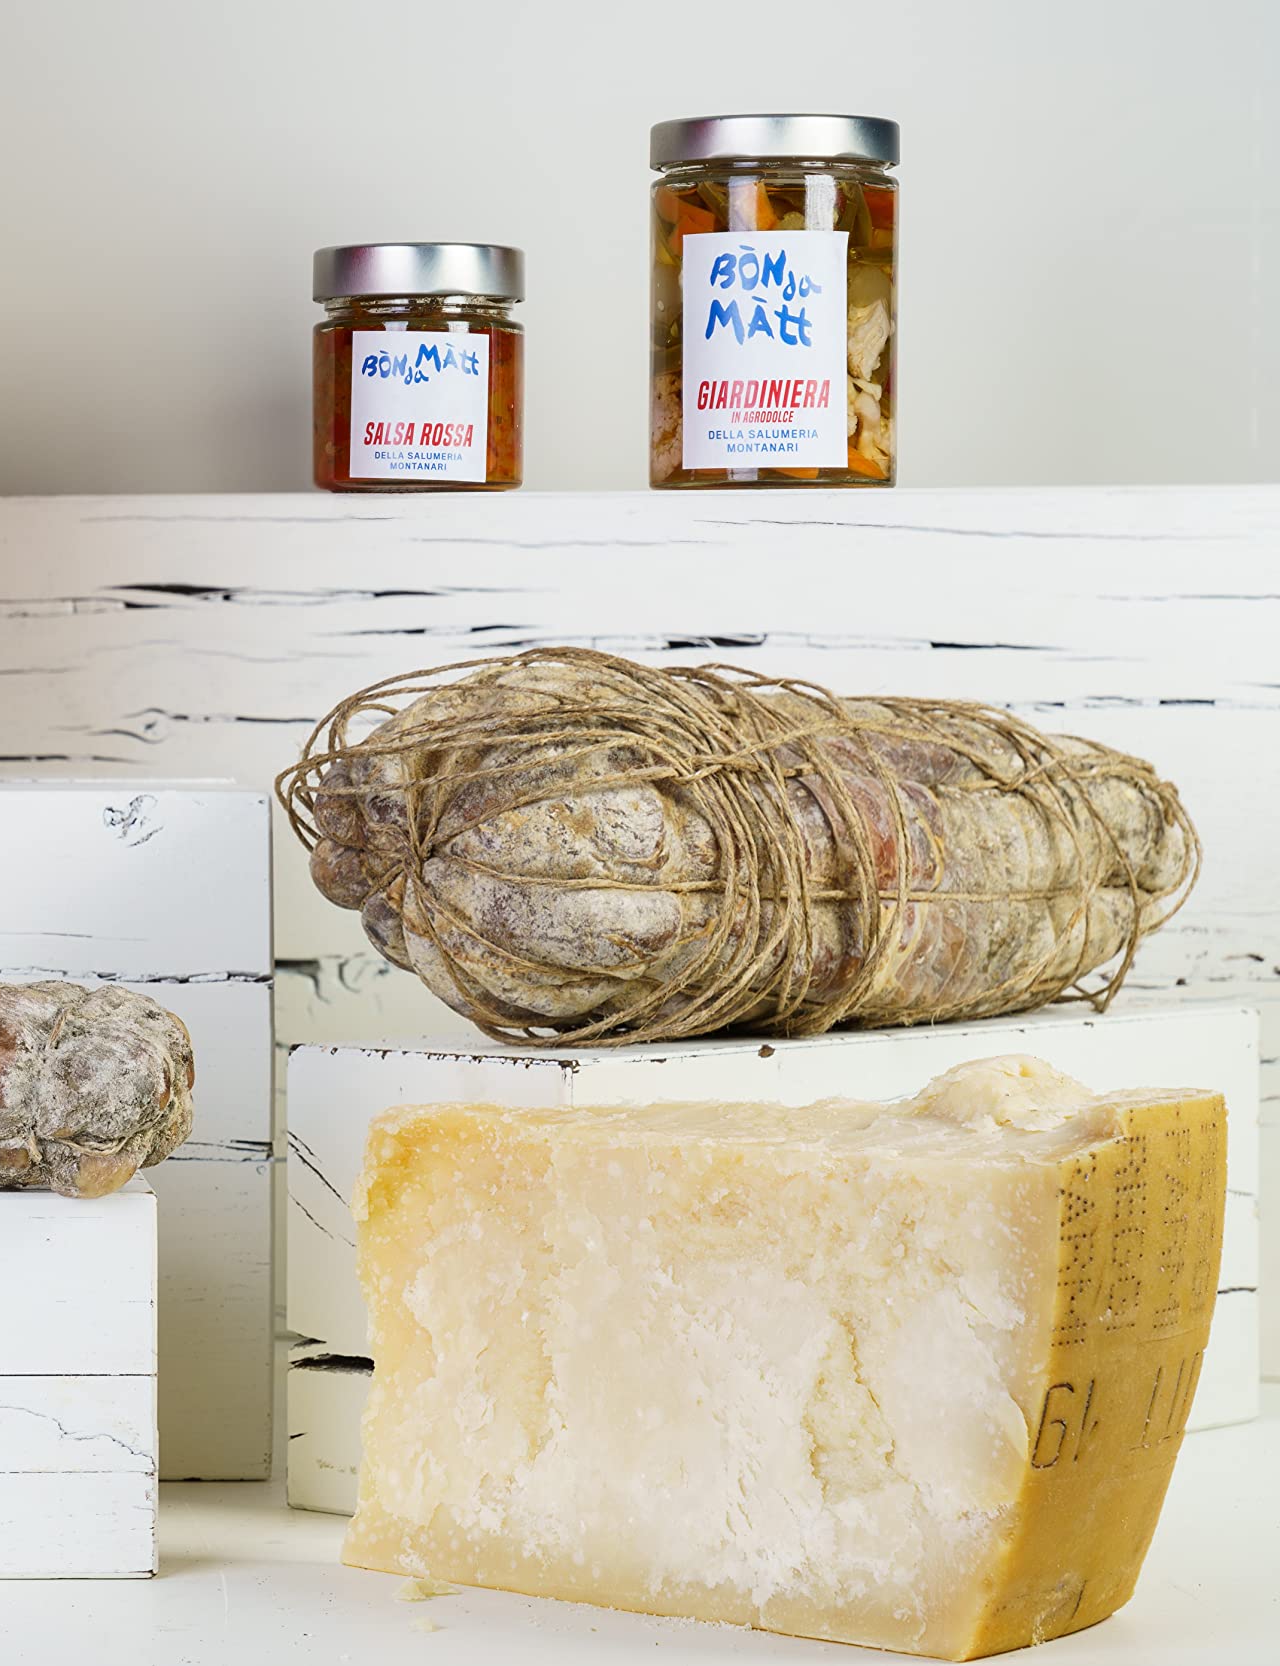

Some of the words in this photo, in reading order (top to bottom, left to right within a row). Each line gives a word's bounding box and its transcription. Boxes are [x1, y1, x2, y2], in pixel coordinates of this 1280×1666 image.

[697, 379, 831, 410] GIARDINIERA
[731, 412, 741, 423] IN
[743, 410, 794, 423] AGRODOLCE
[364, 422, 415, 446] SALSA
[420, 423, 473, 447] ROSSA
[708, 429, 744, 440] DELLA
[748, 429, 819, 440] SALUMERIA
[727, 442, 799, 453] MONTANARI
[375, 451, 404, 460] DELLA
[407, 452, 463, 461] SALUMERIA
[390, 462, 447, 471] MONTANARI
